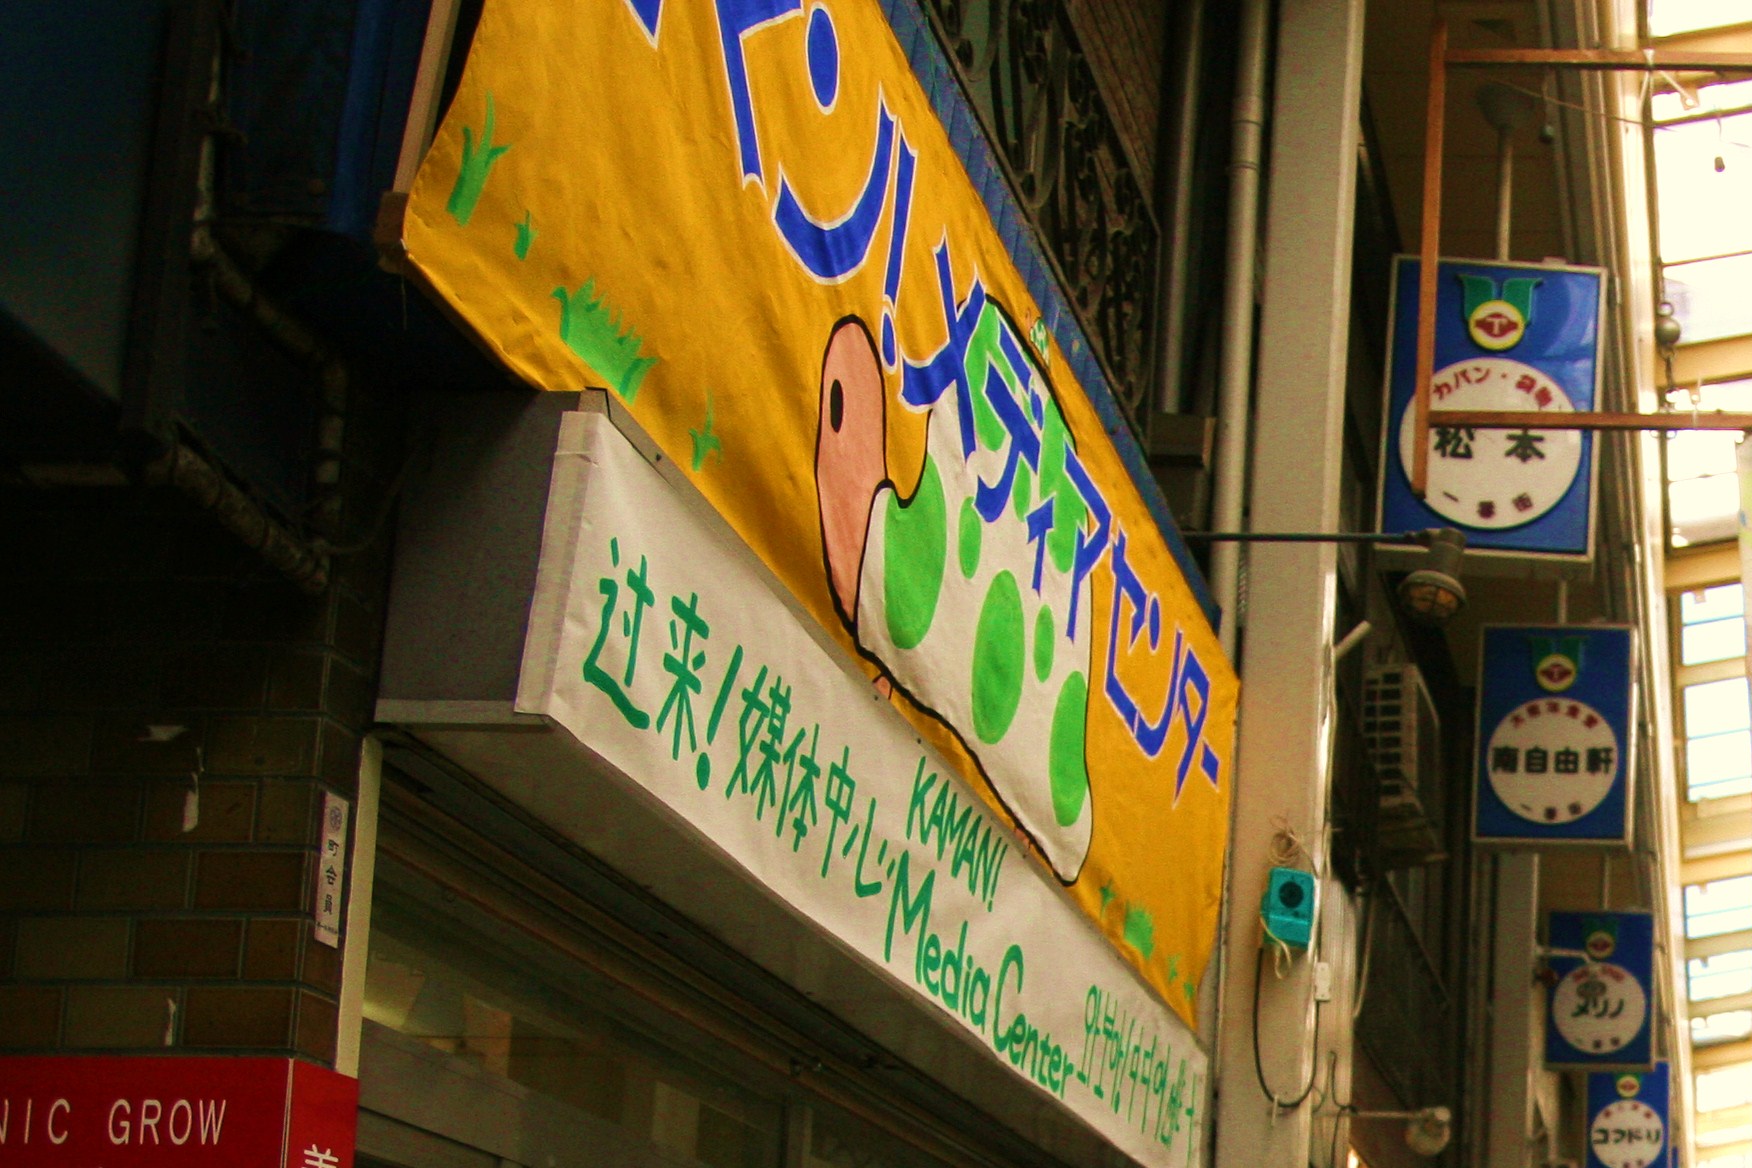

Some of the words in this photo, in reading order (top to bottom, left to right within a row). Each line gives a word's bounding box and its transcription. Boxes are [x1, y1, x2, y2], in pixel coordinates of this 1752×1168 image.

[907, 757, 1009, 913] KAMAN!
[885, 850, 993, 1035] Media
[993, 943, 1074, 1100] Center
[107, 1098, 228, 1145] GROW
